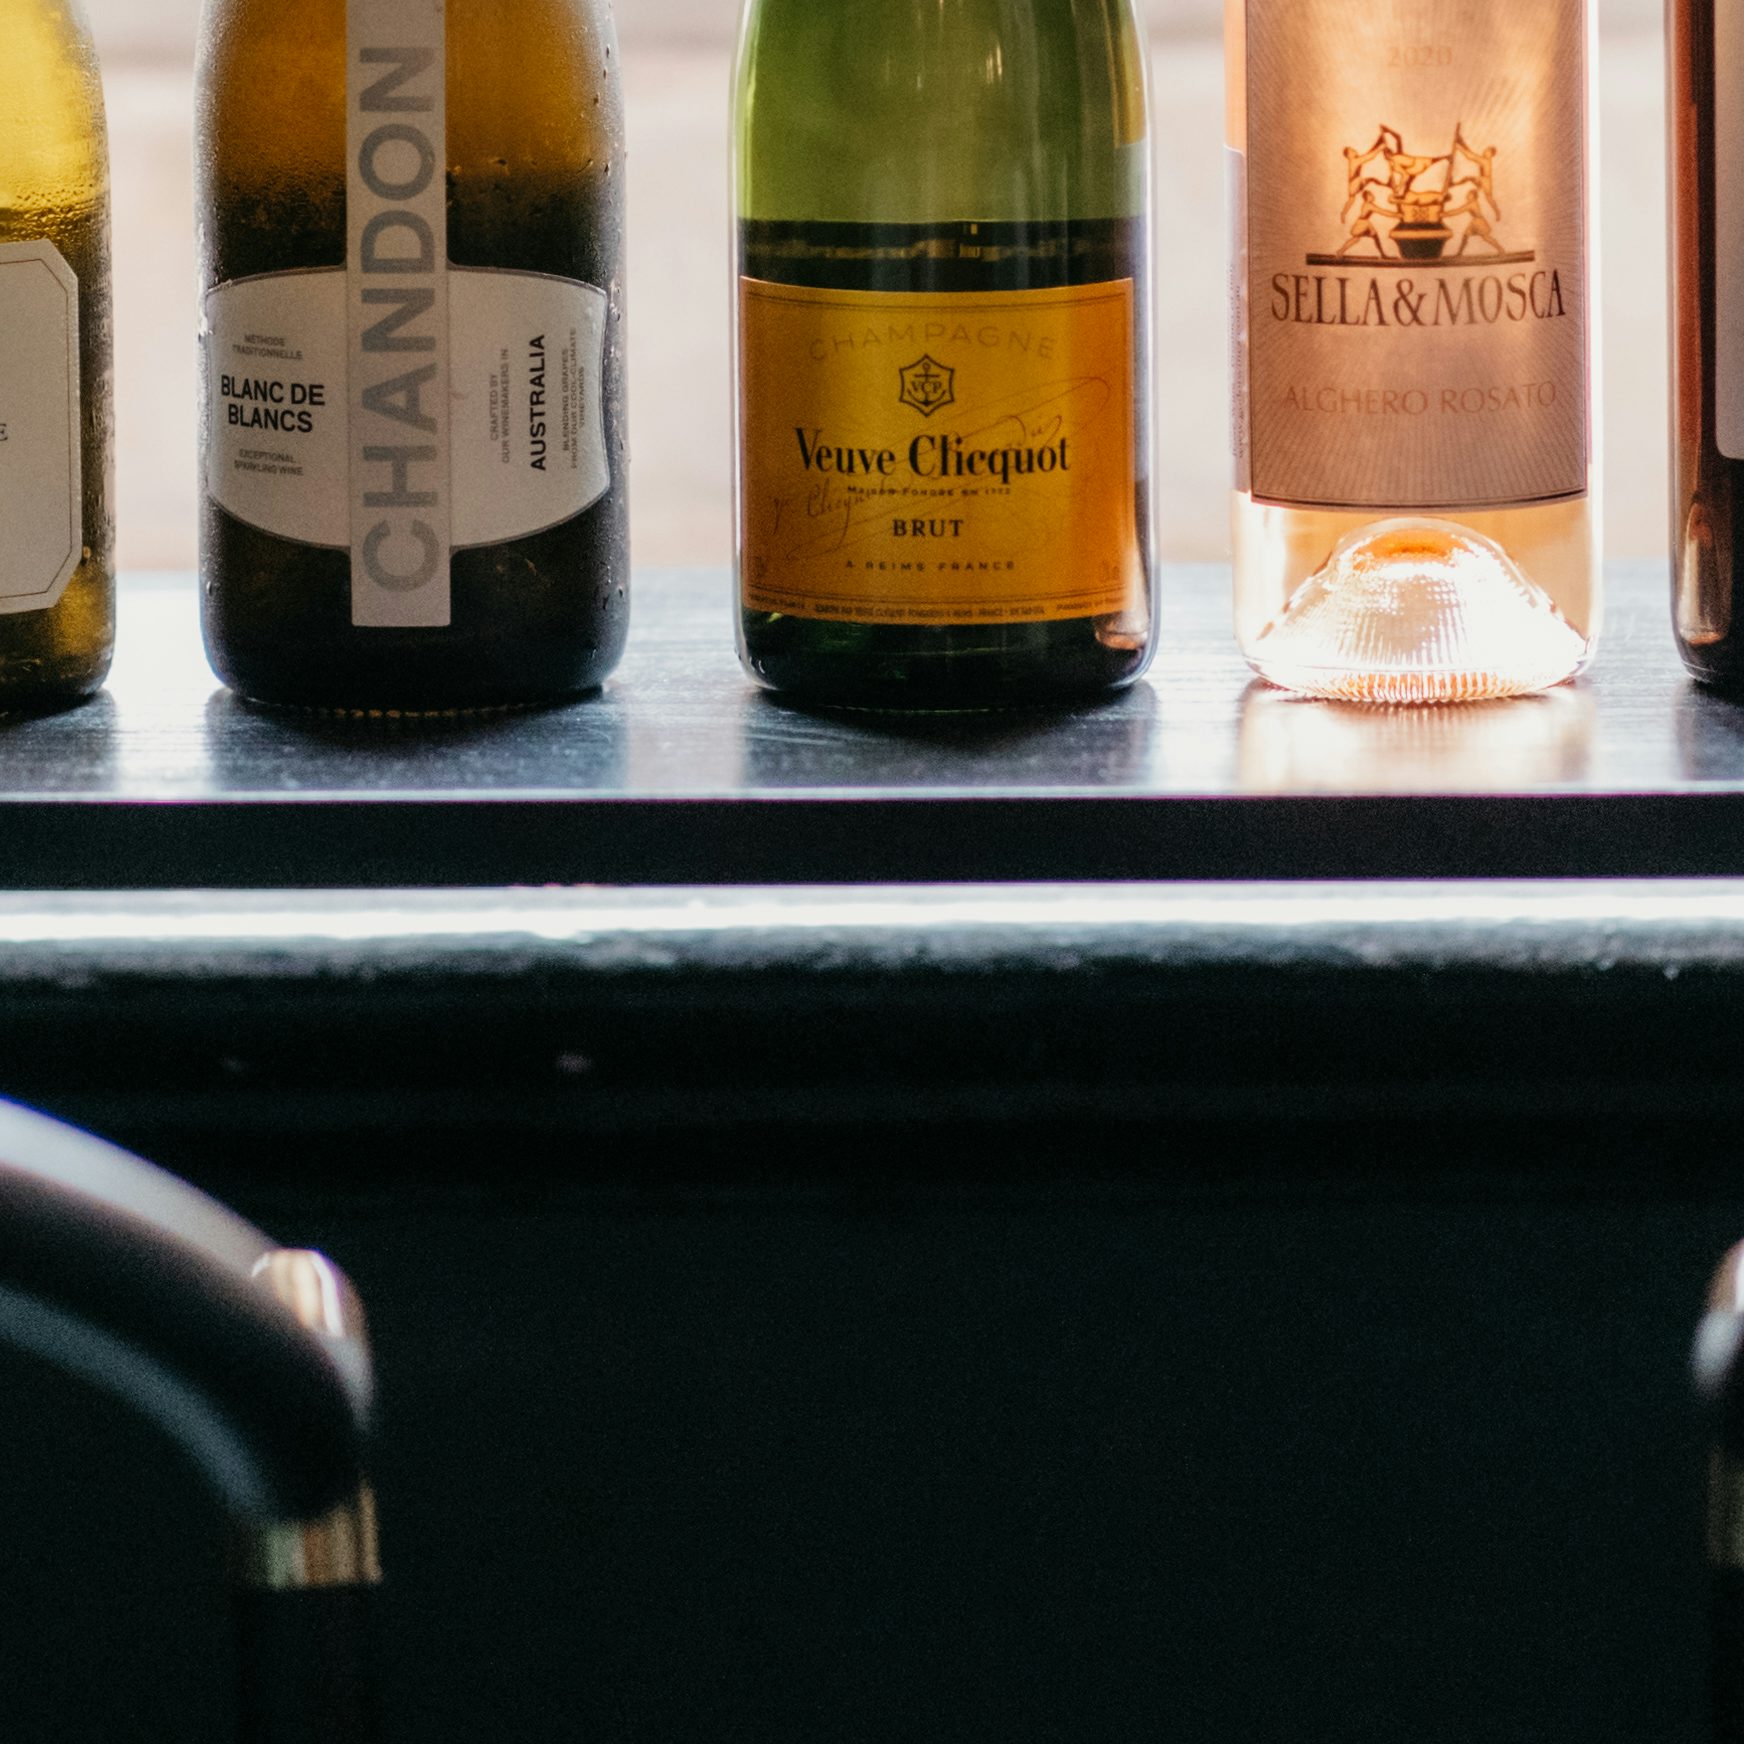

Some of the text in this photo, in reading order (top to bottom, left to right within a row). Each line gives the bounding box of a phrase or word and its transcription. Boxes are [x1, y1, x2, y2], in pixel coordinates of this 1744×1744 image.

[1387, 44, 1454, 68] 2020
[357, 46, 440, 594] CHANDON
[807, 321, 1057, 362] CHAMPAGNE
[220, 375, 326, 406] BLANC DE
[489, 373, 498, 441] CRAFTED BY
[500, 362, 510, 438] WINEMAKERS
[528, 334, 547, 472] AUSTRALIA
[1281, 379, 1557, 417] ALGHERO ROSATO
[227, 403, 314, 433] BLANCS
[561, 393, 570, 452] BLENDING
[570, 411, 578, 435] OUR
[501, 438, 510, 464] OUR
[793, 426, 1072, 485] Veuve Clicquot
[892, 518, 965, 538] BRUT
[936, 560, 1015, 571] FRANCE
